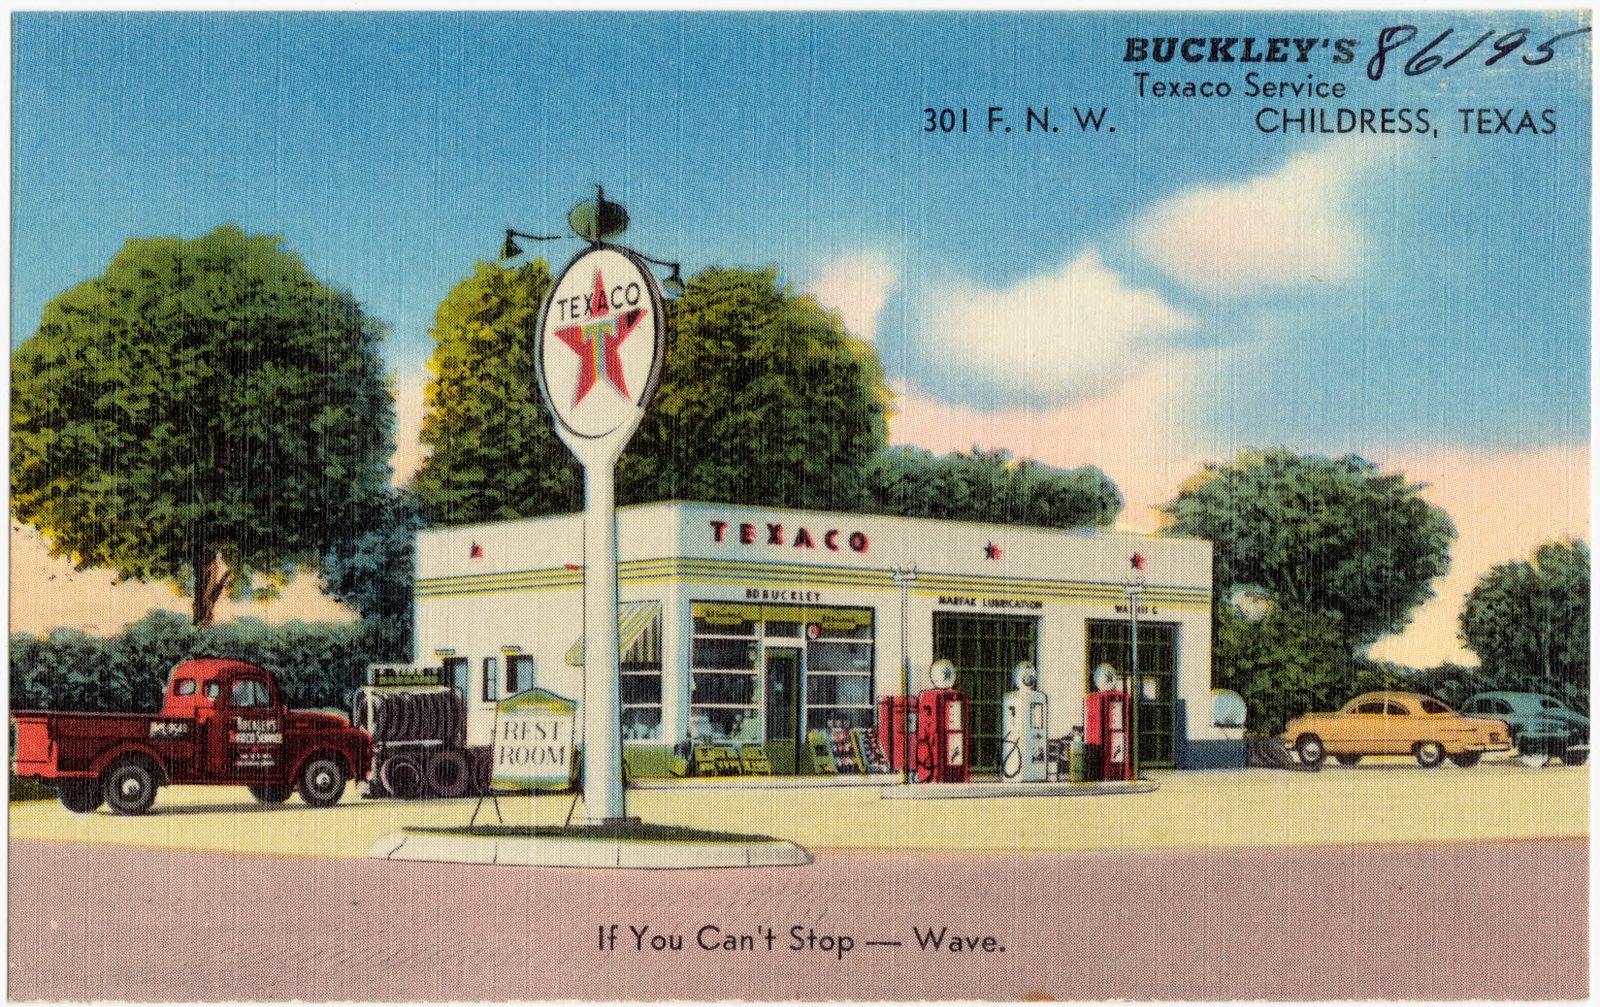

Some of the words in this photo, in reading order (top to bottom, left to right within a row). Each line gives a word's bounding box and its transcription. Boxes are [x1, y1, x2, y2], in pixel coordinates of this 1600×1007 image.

[1367, 24, 1592, 81] 86195
[557, 281, 641, 322] TEXACO
[709, 520, 871, 555] TEXACO
[503, 721, 564, 741] REST
[498, 745, 566, 767] ROOM
